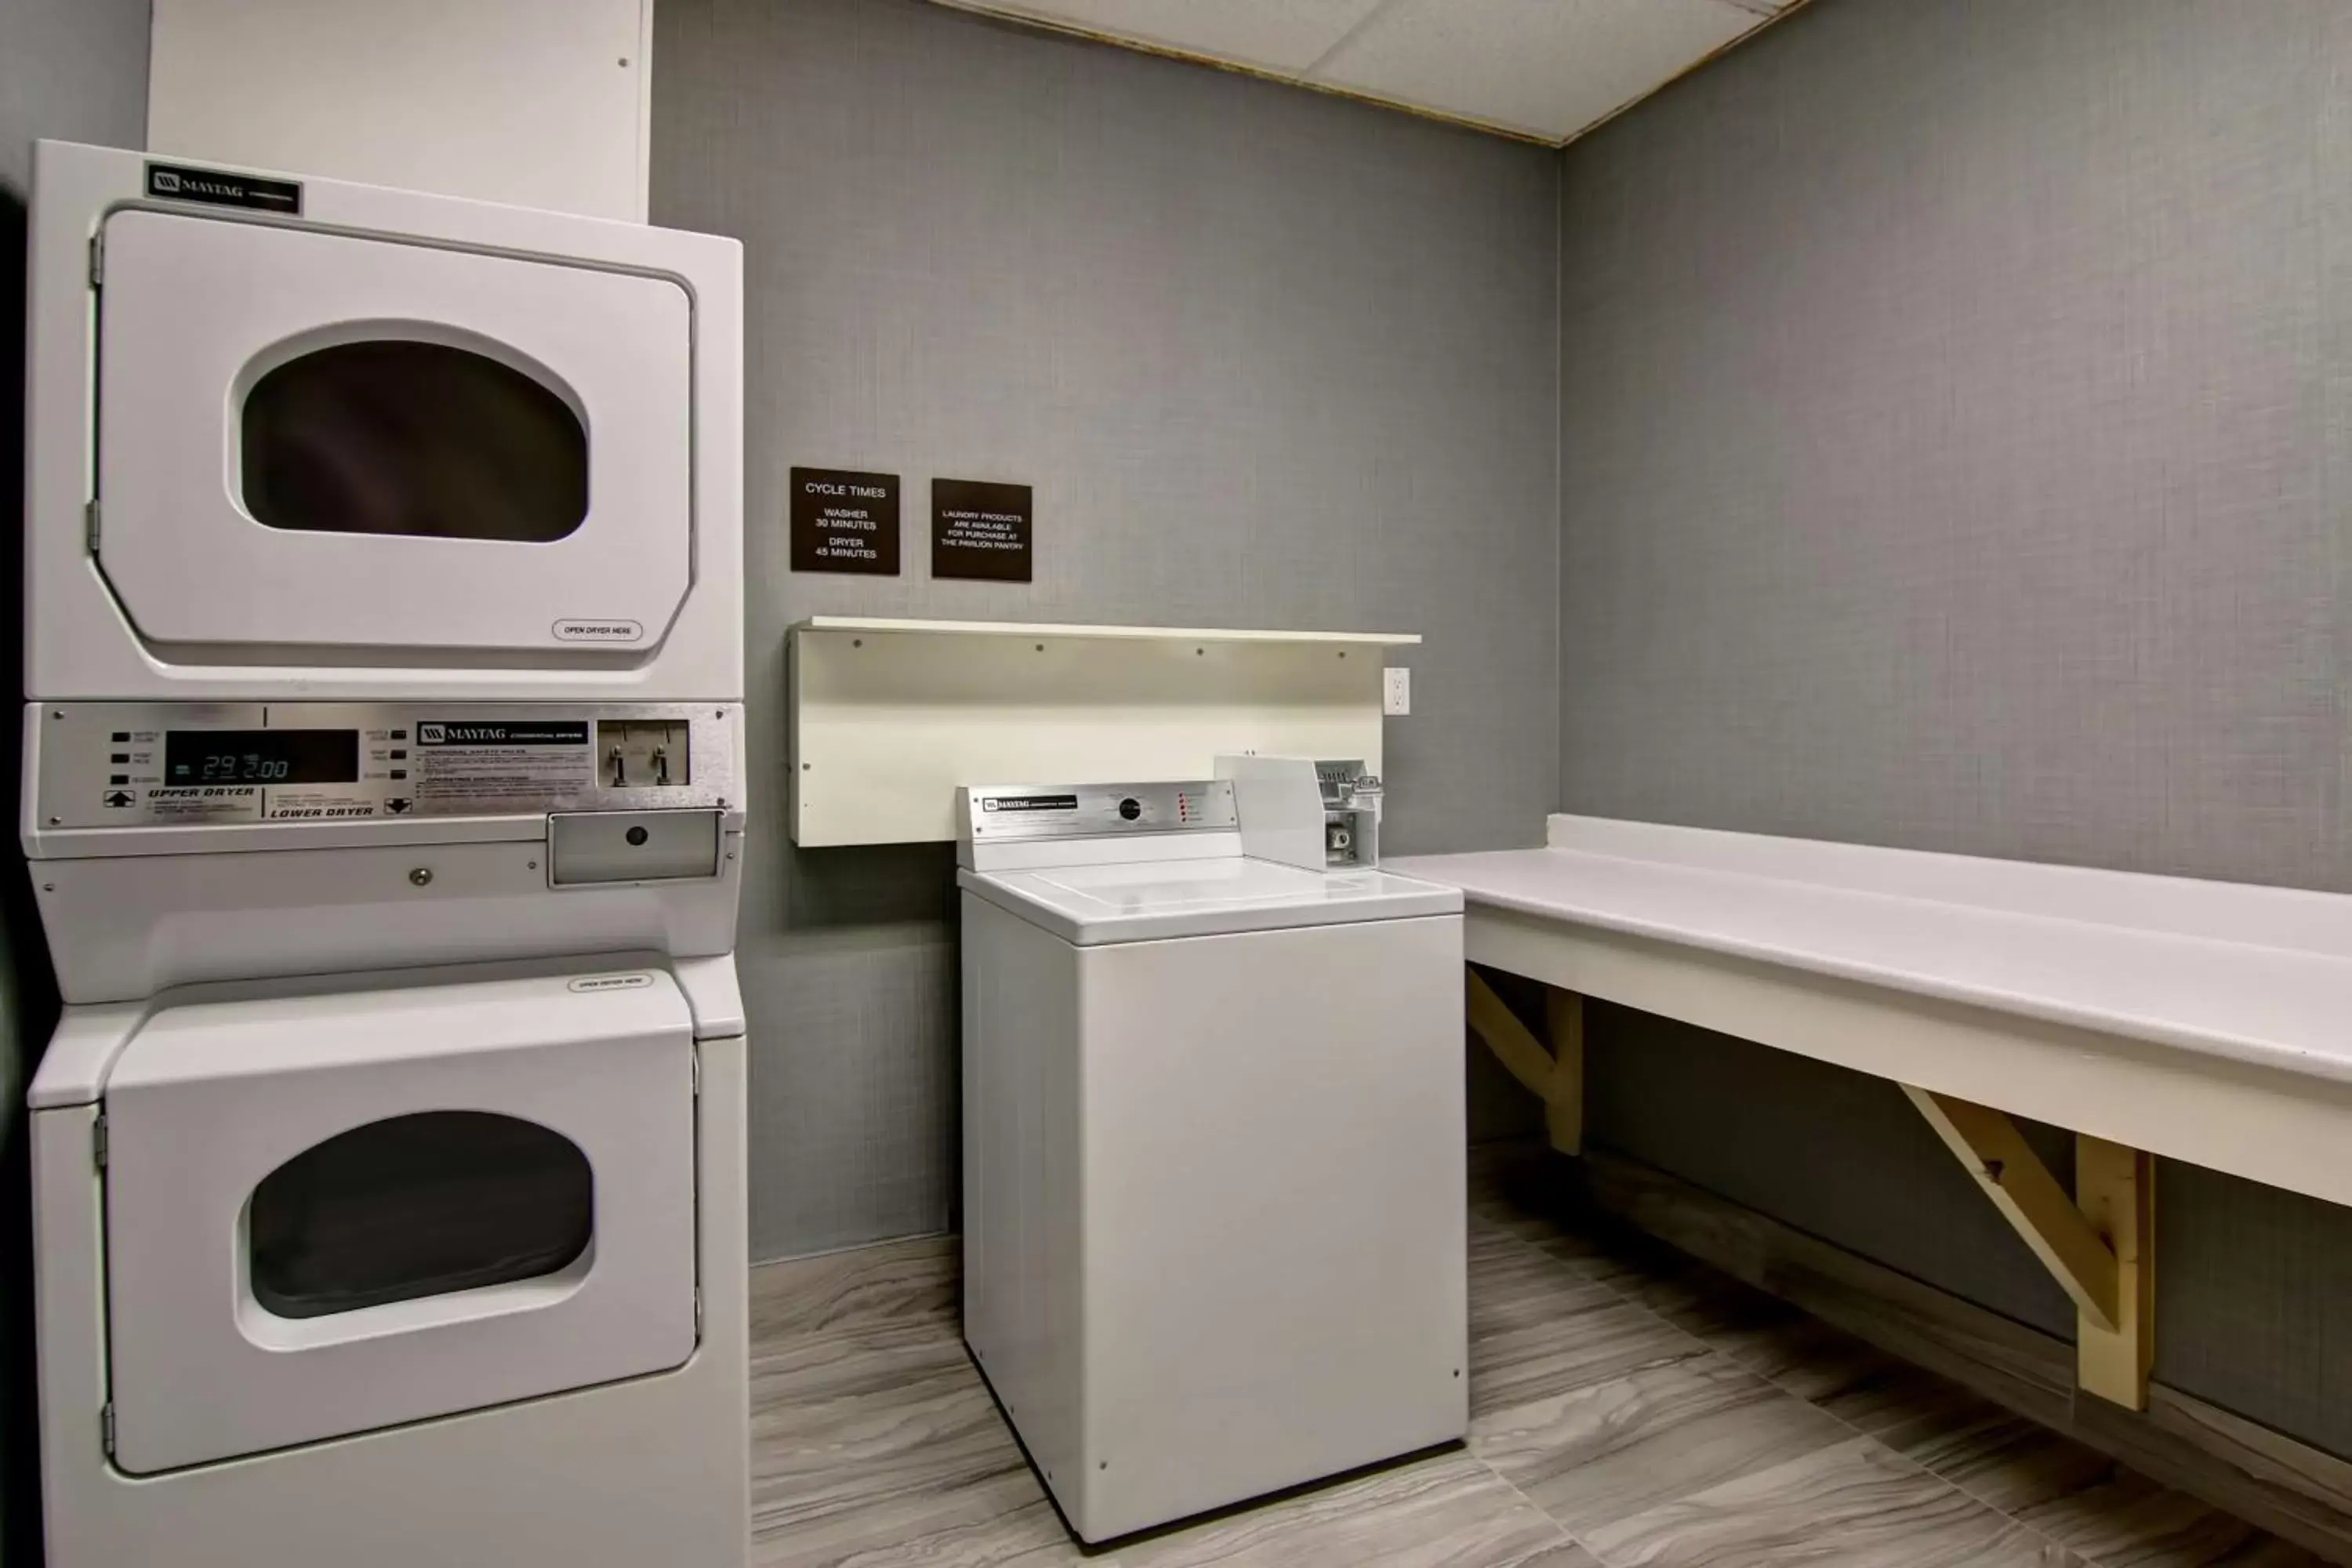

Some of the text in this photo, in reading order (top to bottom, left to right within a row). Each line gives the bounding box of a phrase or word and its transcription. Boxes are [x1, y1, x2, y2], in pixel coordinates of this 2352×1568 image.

[181, 179, 244, 198] MAYTAG
[805, 482, 886, 498] CYCLE TIMES
[824, 508, 868, 519] WASHER
[942, 510, 1022, 523] LAUNDRY PRODUCTS
[815, 518, 877, 531] 30 MINUTES
[965, 531, 1007, 540] PURCHASE
[829, 537, 863, 548] DRYER
[815, 546, 877, 560] 45 MINUTES
[447, 728, 506, 740] MAYTAG
[147, 787, 255, 798] UPPER DRYER
[270, 807, 374, 818] LOWER DRYER
